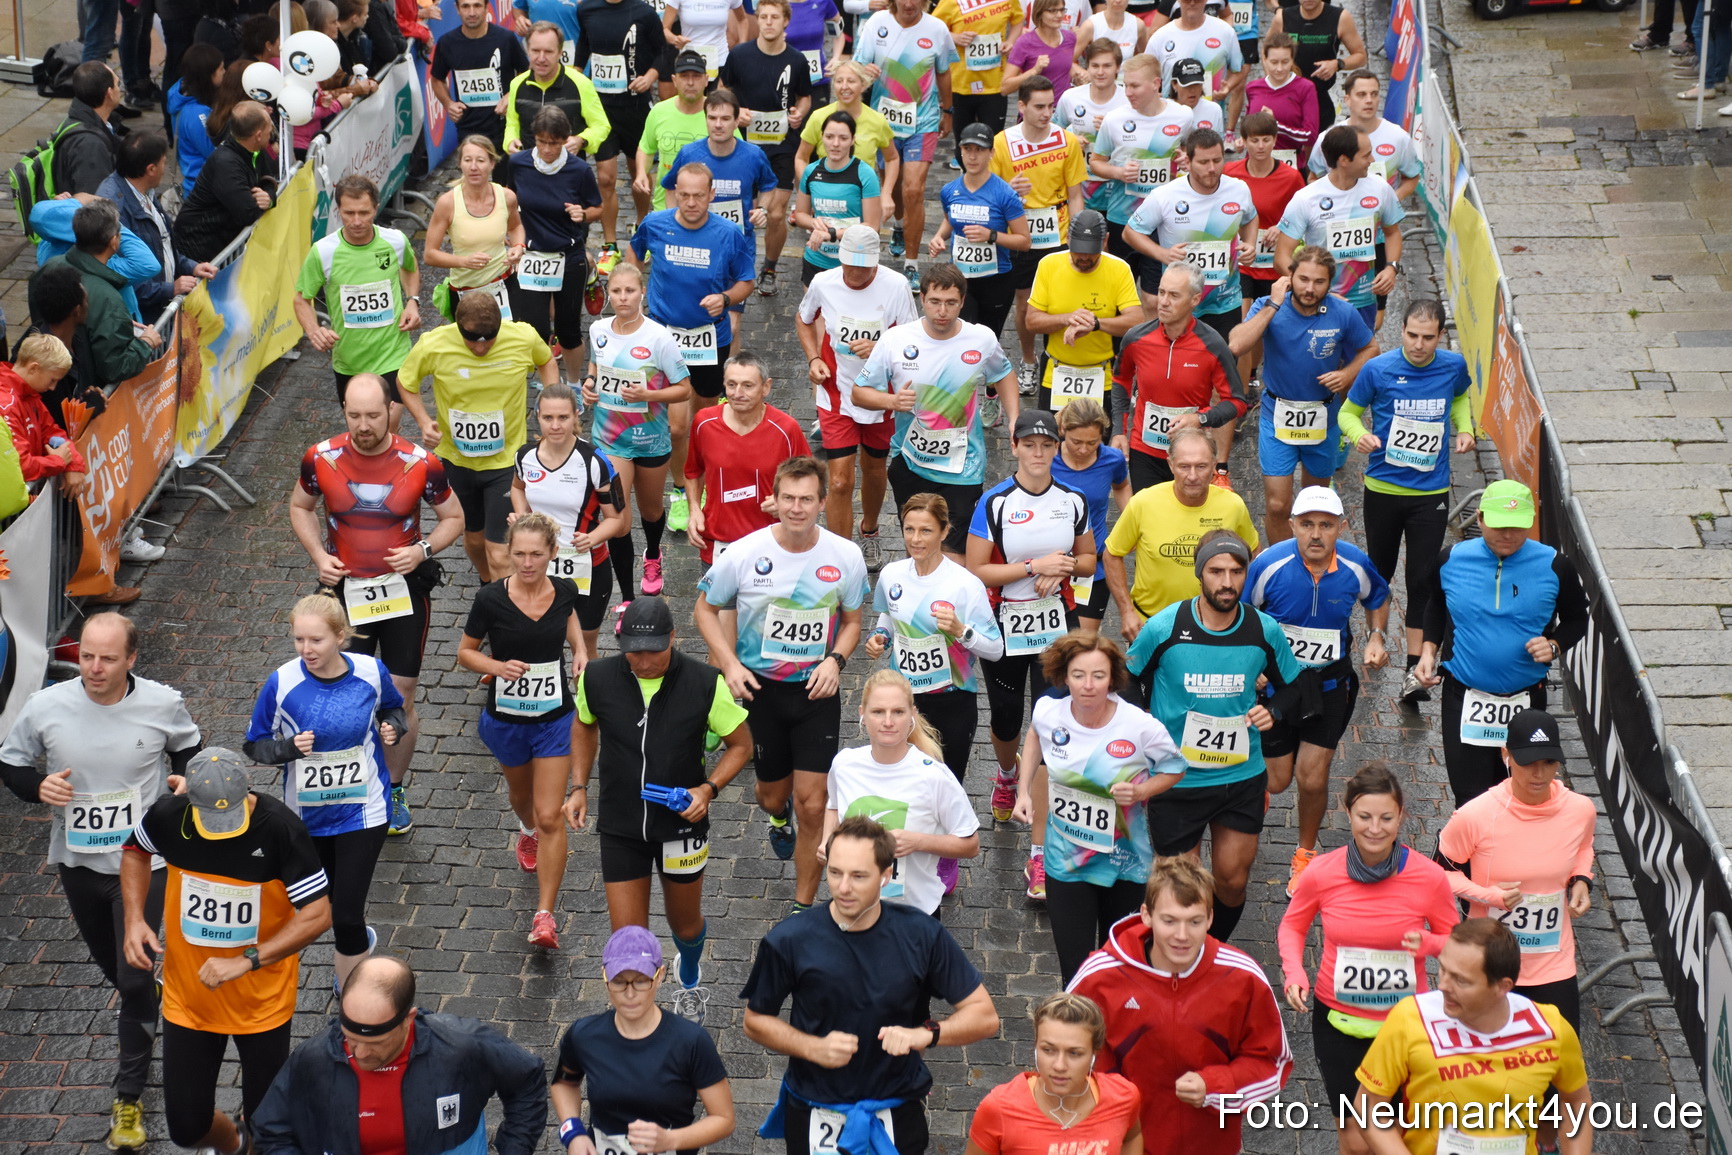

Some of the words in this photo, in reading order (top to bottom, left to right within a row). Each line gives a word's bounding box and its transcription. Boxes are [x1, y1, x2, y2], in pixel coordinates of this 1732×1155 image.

[970, 42, 998, 57] 2811
[594, 64, 622, 79] 2577
[461, 77, 495, 94] 2458
[469, 95, 491, 103] Andreas
[880, 106, 912, 125] 2616
[755, 121, 780, 134] 222
[1013, 158, 1038, 174] MAX
[1041, 152, 1070, 166] BÖGL
[1137, 168, 1166, 184] 596
[950, 204, 990, 216] HUBER
[1029, 217, 1055, 234] 794
[1332, 228, 1372, 248] 2789
[665, 244, 711, 260] HUBER
[957, 246, 993, 263] 2289
[1339, 248, 1367, 258] Matthias
[524, 259, 561, 275] 2027
[1187, 252, 1226, 268] 2514
[969, 265, 979, 273] Evi
[1203, 272, 1218, 280] rkus
[533, 279, 548, 288] Katja
[346, 292, 389, 312] 2553
[356, 313, 383, 323] Herbert
[672, 331, 711, 349] 2420
[680, 350, 703, 360] Werner
[1063, 376, 1095, 395] 267
[613, 397, 628, 406] Lisa
[1394, 398, 1446, 411] HUBER
[1285, 410, 1317, 428] 207
[454, 421, 500, 441] 2020
[632, 427, 645, 436] 17.
[1290, 431, 1310, 439] Frank
[463, 442, 493, 452] Manfred
[909, 429, 951, 456] 2323
[1393, 429, 1439, 453] 2222
[913, 450, 935, 463] Stefan
[1395, 450, 1430, 465] Christoph
[527, 470, 540, 479] tkn
[732, 490, 747, 498] DEHN
[1010, 511, 1027, 520] tkn
[819, 568, 839, 579] Hervis
[365, 584, 388, 601] 31
[370, 604, 390, 614] Felix
[1010, 608, 1060, 634] 2218
[770, 620, 823, 642] 2493
[1027, 637, 1047, 646] Hana
[781, 645, 808, 655] Arnold
[899, 647, 944, 673] 2635
[503, 676, 556, 697] 2875
[908, 676, 933, 687] Conny
[1184, 673, 1245, 687] HUBER
[519, 702, 539, 711] Rosi
[1196, 728, 1238, 751] 241
[1483, 729, 1505, 739] Hans
[1110, 743, 1133, 755] Hervis
[1199, 752, 1228, 764] Daniel
[304, 762, 362, 789] 2672
[320, 791, 346, 801] Laura
[72, 802, 132, 830] 2671
[1054, 797, 1109, 831] 2318
[87, 834, 121, 845] Jürgen
[1064, 825, 1094, 842] Andrea
[187, 894, 253, 924] 2810
[201, 927, 232, 940] Bernd
[1515, 933, 1540, 946] icola
[1343, 965, 1410, 991] 2023
[1352, 993, 1400, 1005] Elisabeth
[1438, 1058, 1495, 1082] MAX
[1503, 1047, 1560, 1072] BÖGL
